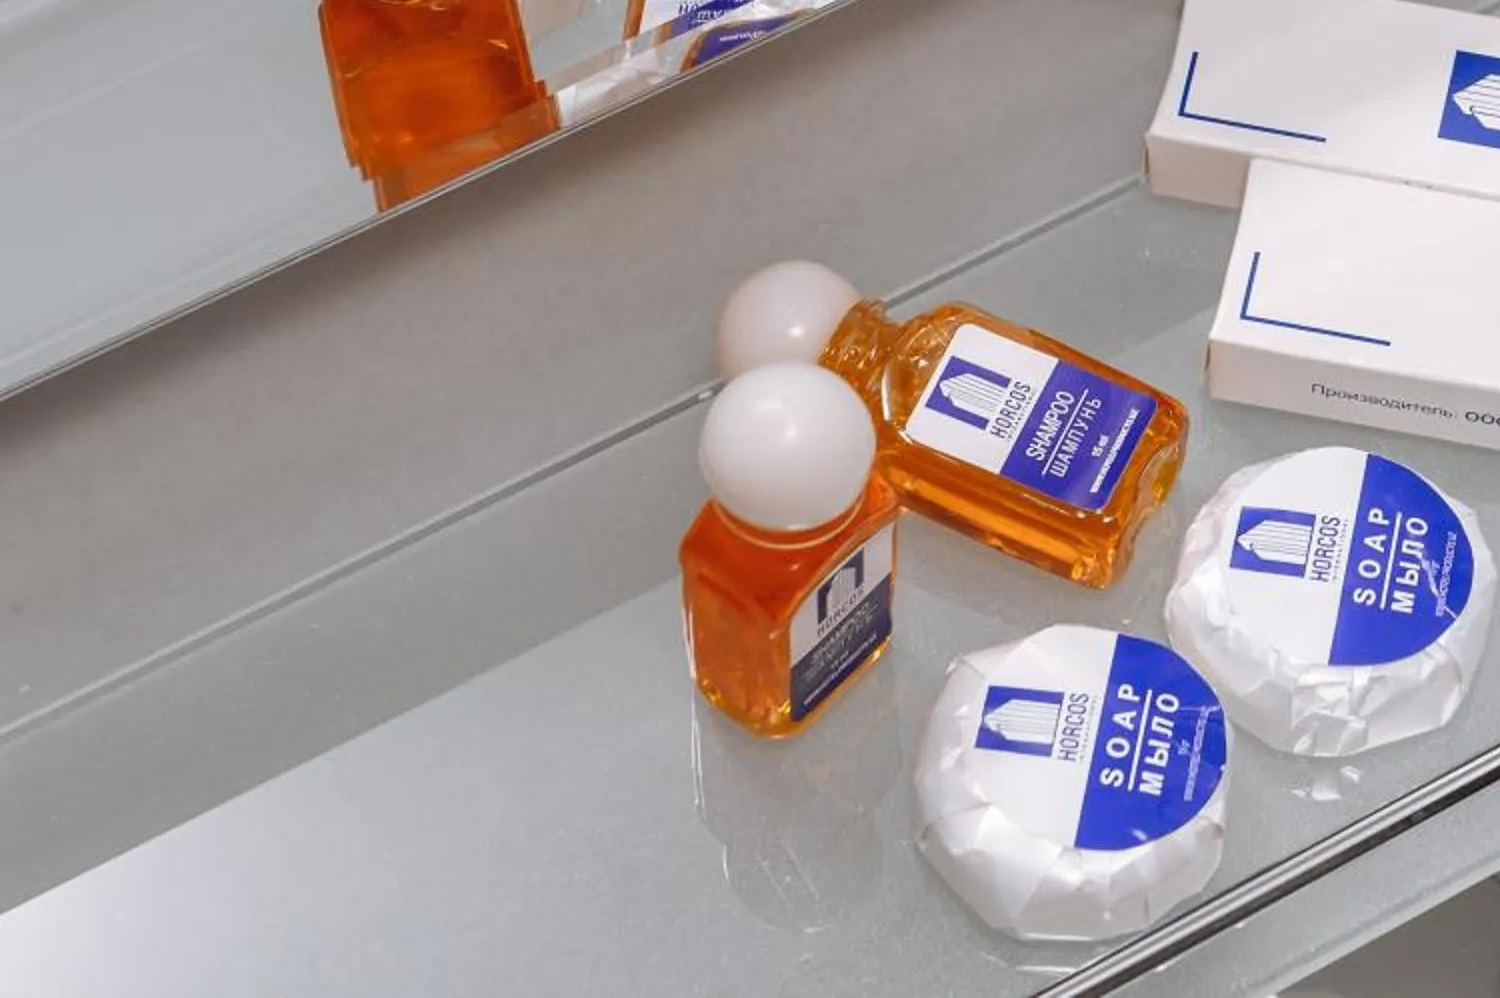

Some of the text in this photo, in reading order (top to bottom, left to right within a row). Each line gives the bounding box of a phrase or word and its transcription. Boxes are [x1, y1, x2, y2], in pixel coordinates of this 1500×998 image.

[990, 381, 1031, 440] HORCOS
[1025, 390, 1075, 462] SHAMPOO
[1050, 398, 1102, 479] ШАМПУНЬ
[1309, 515, 1341, 583] HORCOS
[1353, 507, 1390, 607] SOAP
[1391, 517, 1429, 615] МЫЛО
[1058, 692, 1090, 762] HORCOS
[1101, 683, 1141, 788] SOAP
[1139, 692, 1180, 796] МЫЛО
